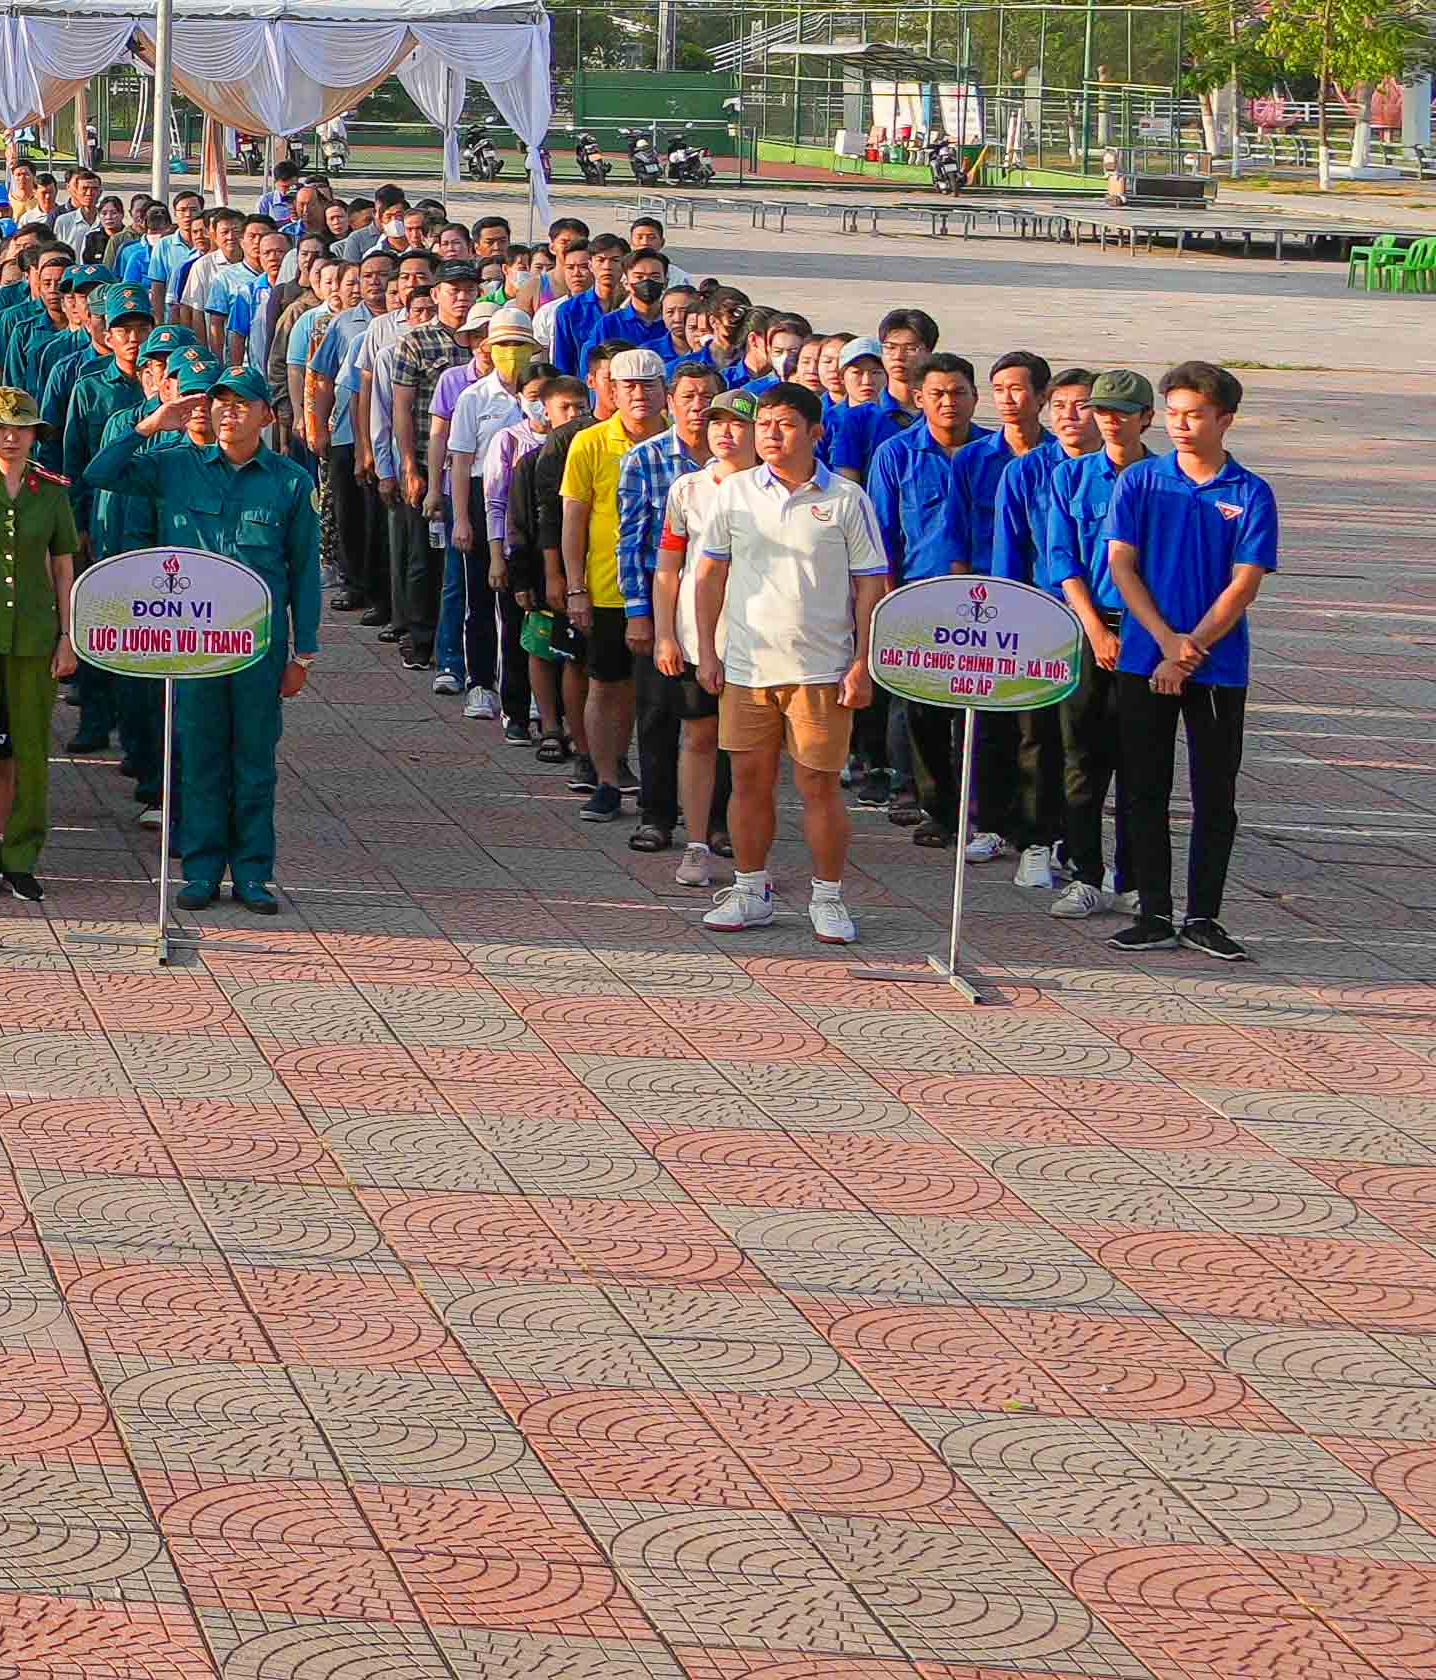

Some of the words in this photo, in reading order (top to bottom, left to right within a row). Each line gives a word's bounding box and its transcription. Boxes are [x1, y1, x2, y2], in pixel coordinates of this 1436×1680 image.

[132, 599, 182, 618] ĐƠN
[191, 601, 212, 624] VỊ
[88, 625, 117, 654] LỰC
[122, 626, 172, 656] LƯỢNG
[177, 627, 198, 653] VŨ
[203, 630, 253, 655] TRANG
[934, 626, 987, 648] ĐƠN
[997, 631, 1019, 655] VỊ
